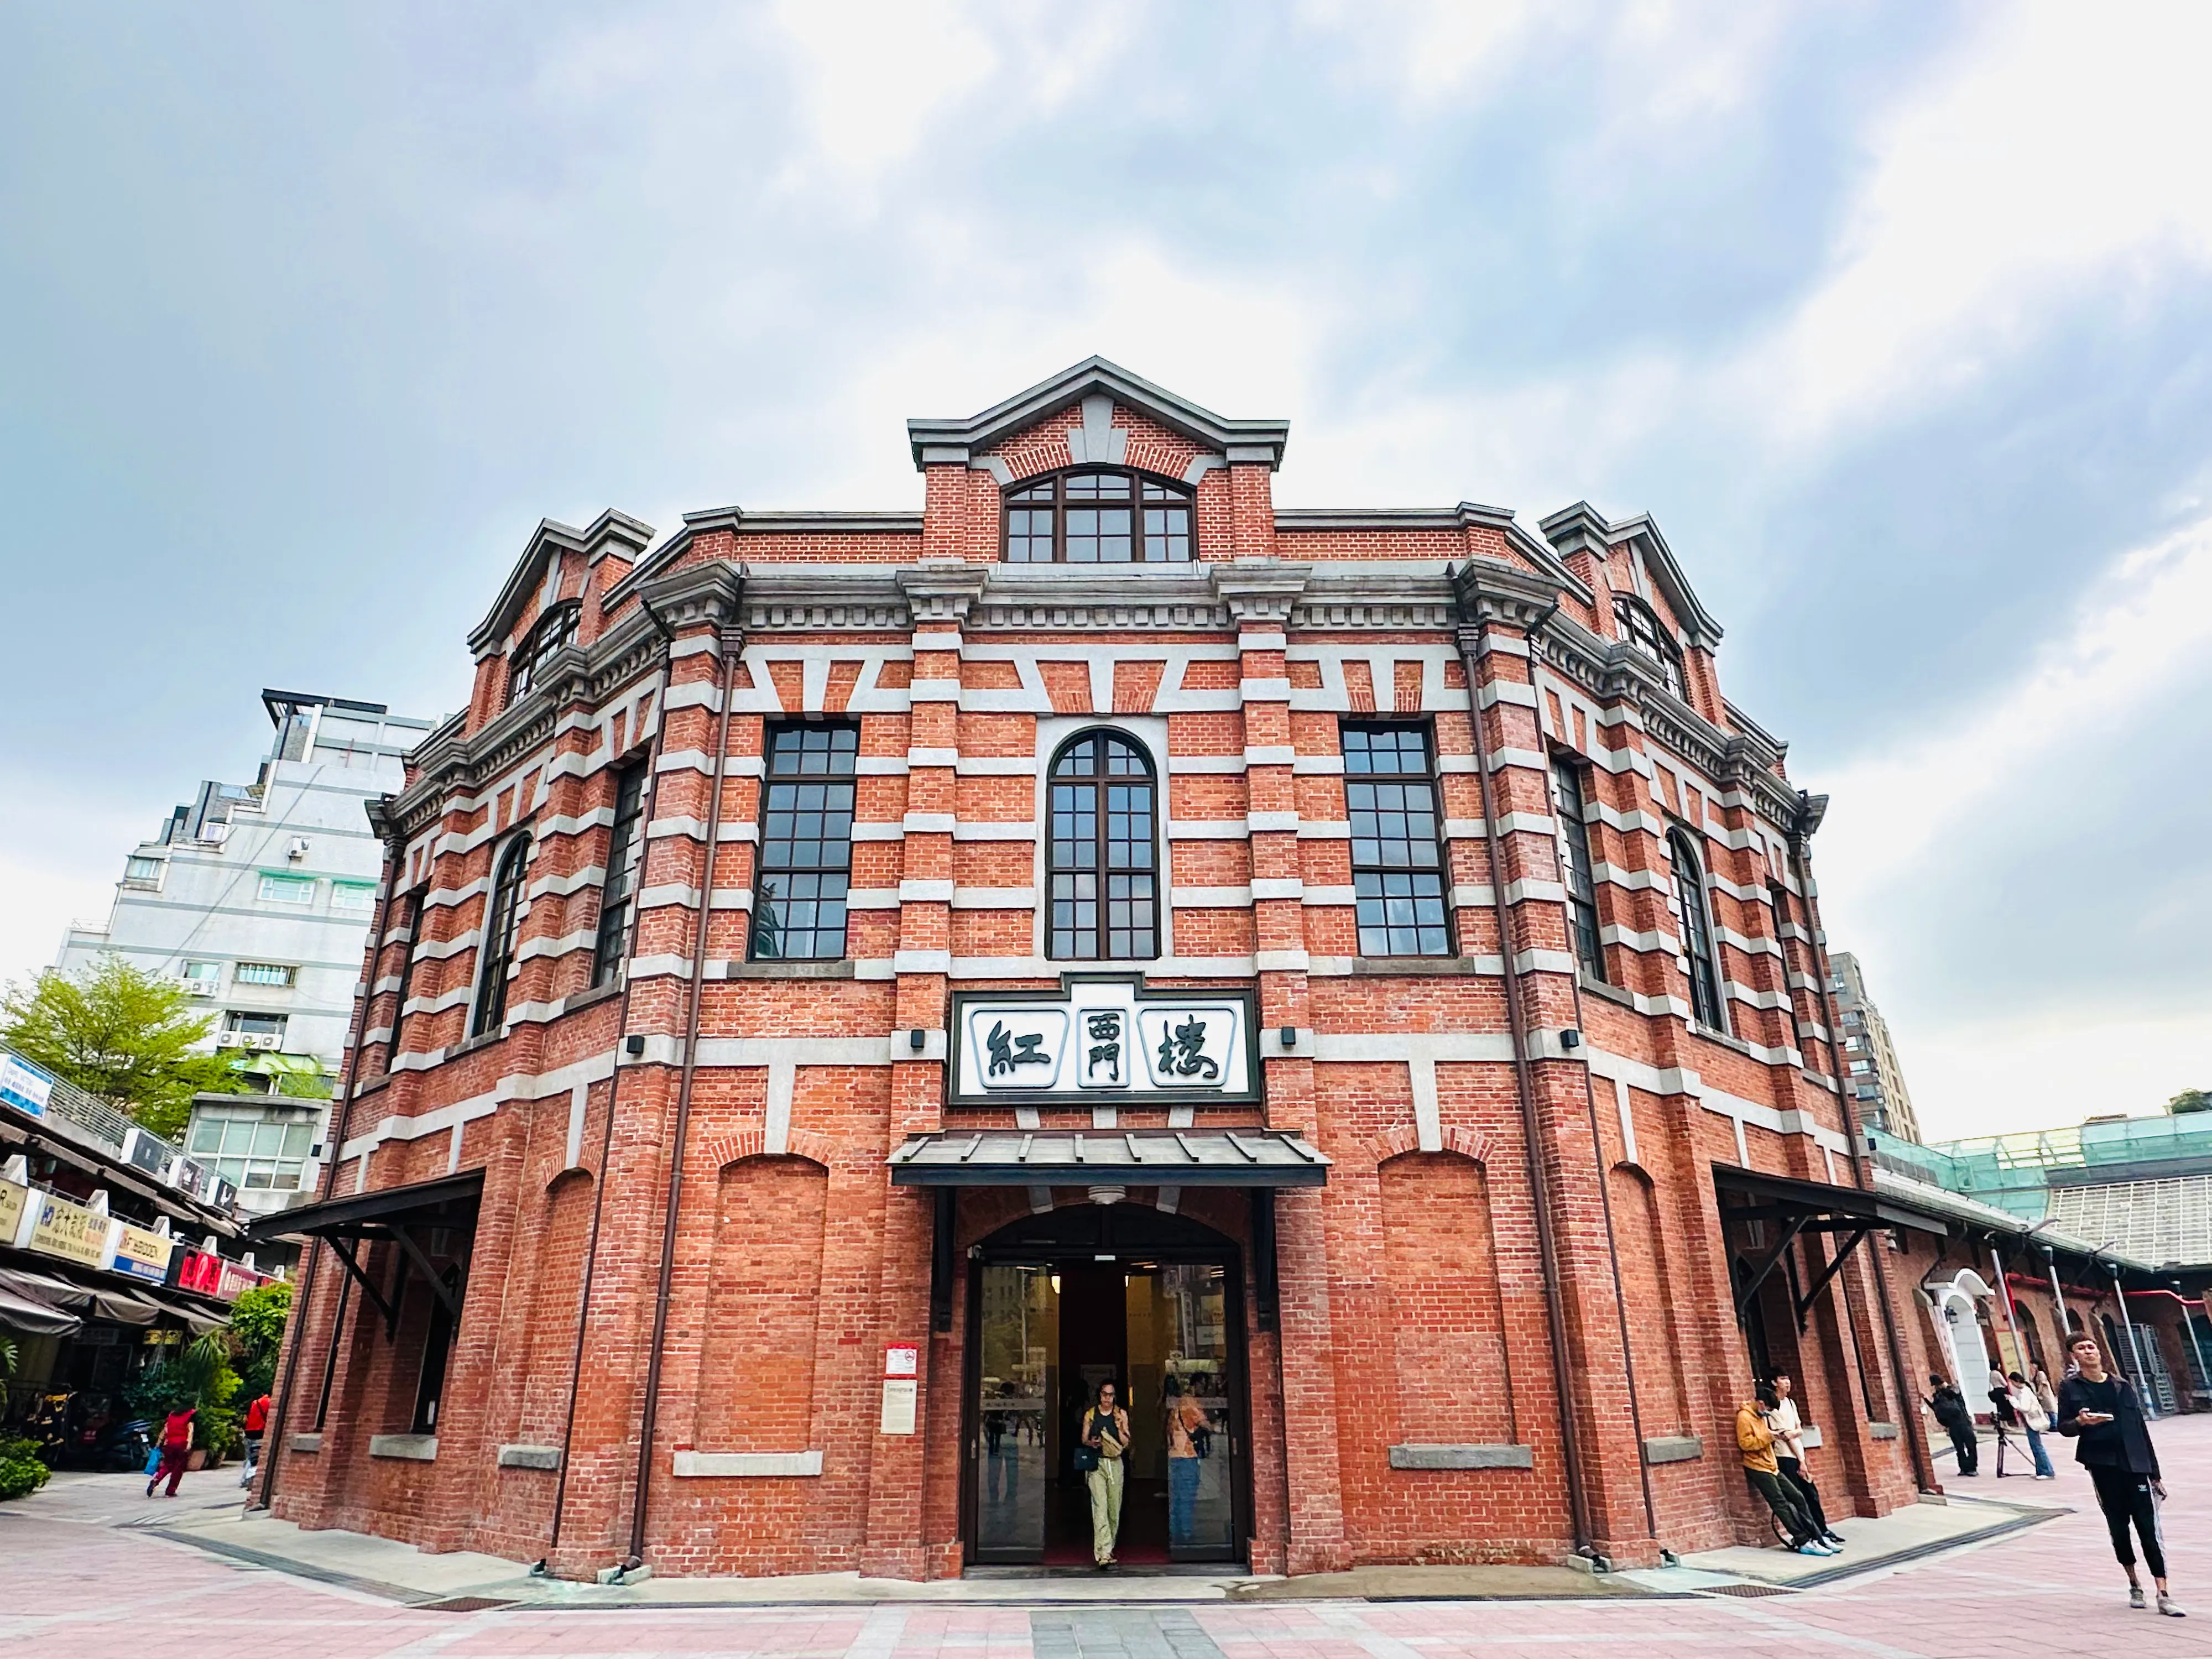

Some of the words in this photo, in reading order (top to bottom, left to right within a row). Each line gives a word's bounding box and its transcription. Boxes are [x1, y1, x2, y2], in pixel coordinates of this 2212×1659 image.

[987, 1020, 1051, 1077] 紅
[1087, 1013, 1120, 1082] 西門
[1158, 1014, 1219, 1080] 樓
